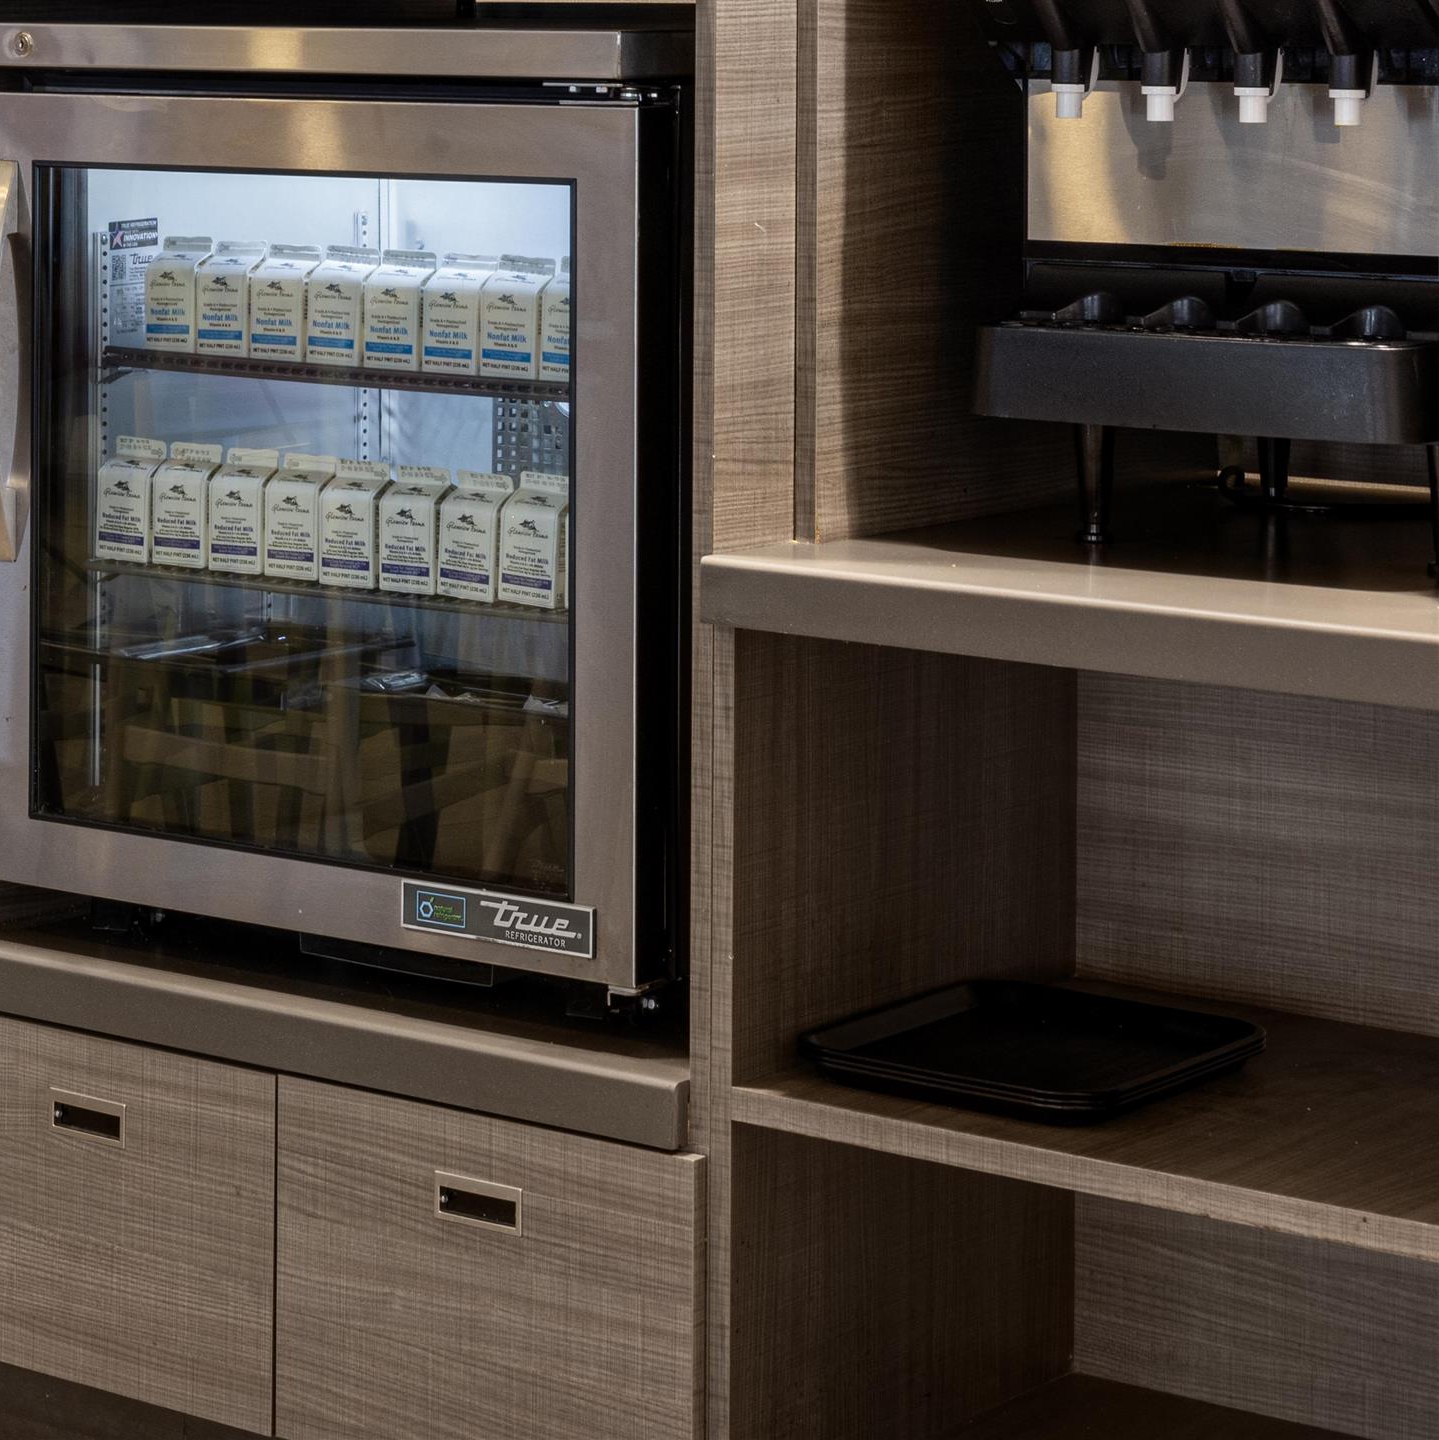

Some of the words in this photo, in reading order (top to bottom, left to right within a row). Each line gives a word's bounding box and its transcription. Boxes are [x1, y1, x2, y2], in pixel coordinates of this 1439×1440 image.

[123, 232, 158, 241] INNOVATION
[150, 308, 170, 316] Nonfat
[172, 308, 185, 316] Milk
[225, 314, 239, 322] Milk
[256, 318, 277, 326] Nonfat
[278, 318, 293, 327] Milk
[312, 320, 333, 329] Nonfat
[335, 321, 351, 330] Milk
[370, 326, 391, 334] Nonfat
[393, 326, 409, 336] Milk
[429, 330, 451, 339] Nonfat
[453, 331, 468, 340] Milk
[487, 332, 510, 342] Nonfat
[512, 333, 527, 343] Milk
[444, 548, 466, 556] Reduced
[505, 553, 527, 561] Reduced
[505, 930, 567, 948] REFRIGERATOR
